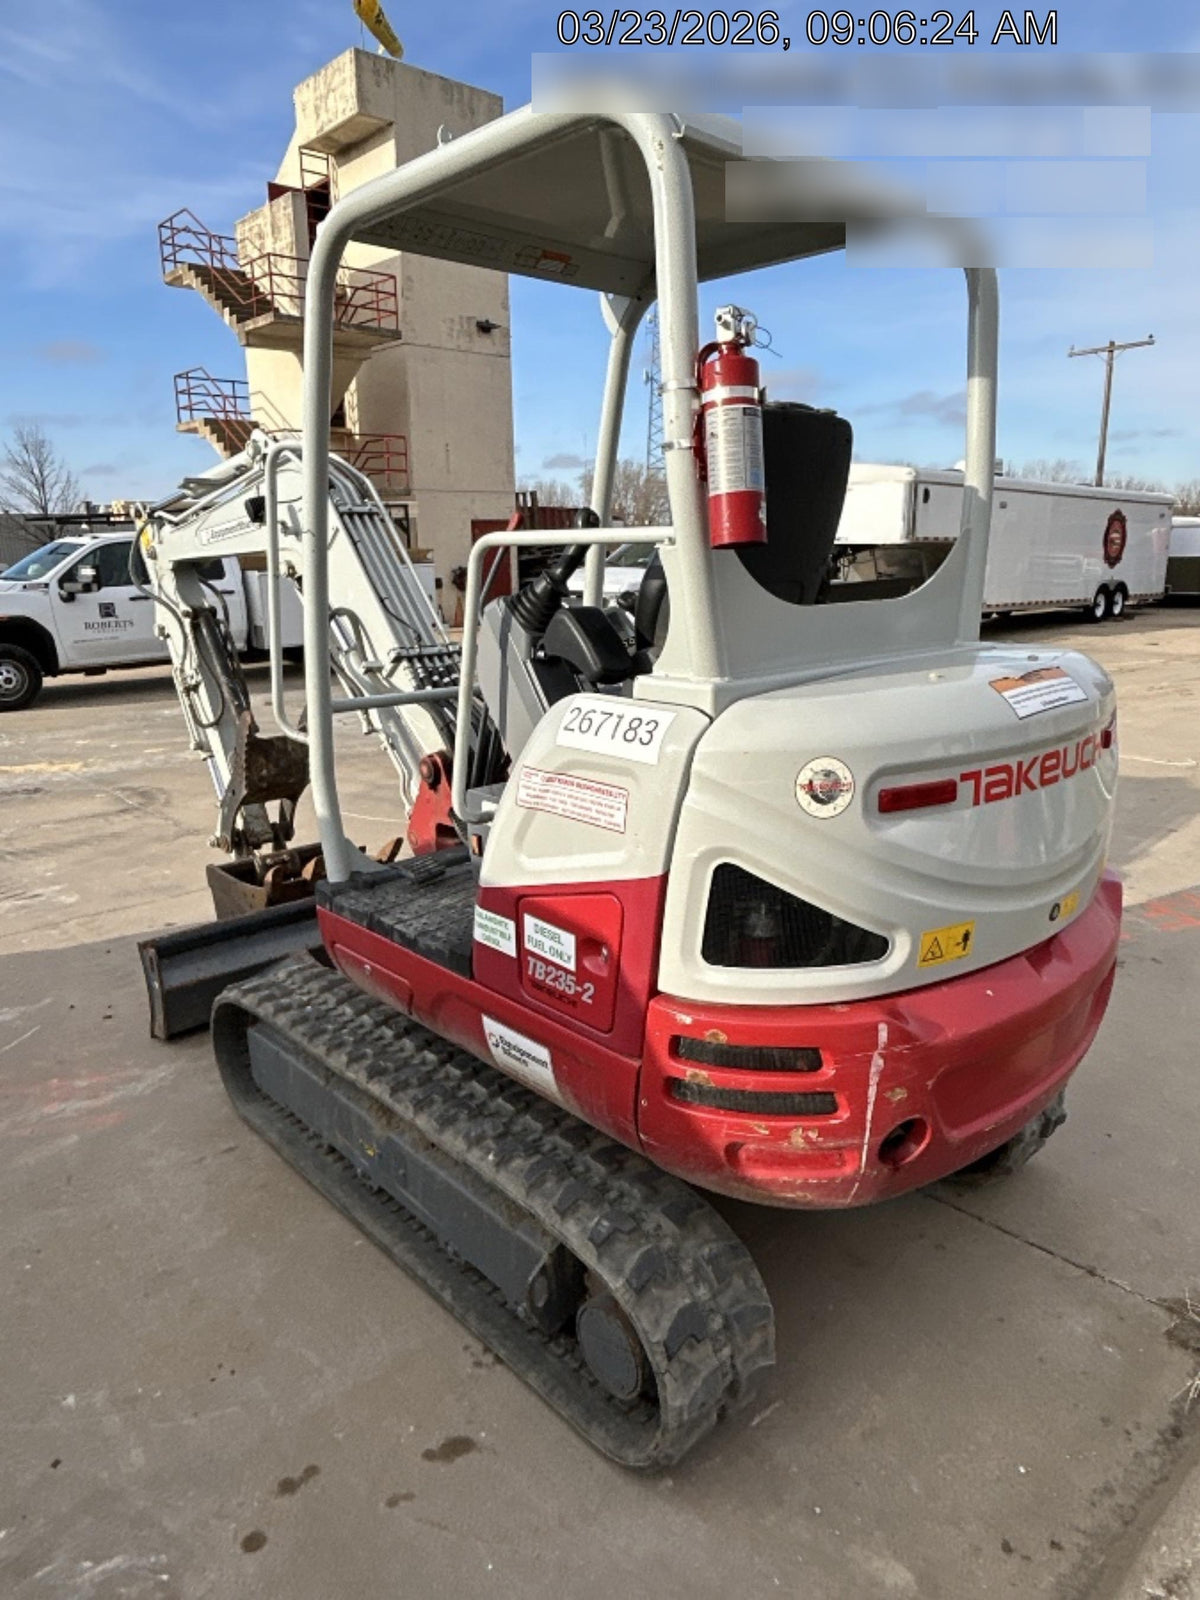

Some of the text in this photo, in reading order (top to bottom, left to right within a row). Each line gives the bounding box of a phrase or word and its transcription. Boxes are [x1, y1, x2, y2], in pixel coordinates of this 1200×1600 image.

[84, 619, 134, 630] ROBERTS
[563, 706, 659, 746] 267183
[959, 734, 1102, 807] TAKEUCH
[527, 934, 548, 954] FUEL
[548, 944, 573, 965] ONLY
[533, 922, 564, 946] DIESEL
[527, 955, 596, 1005] TB235-2
